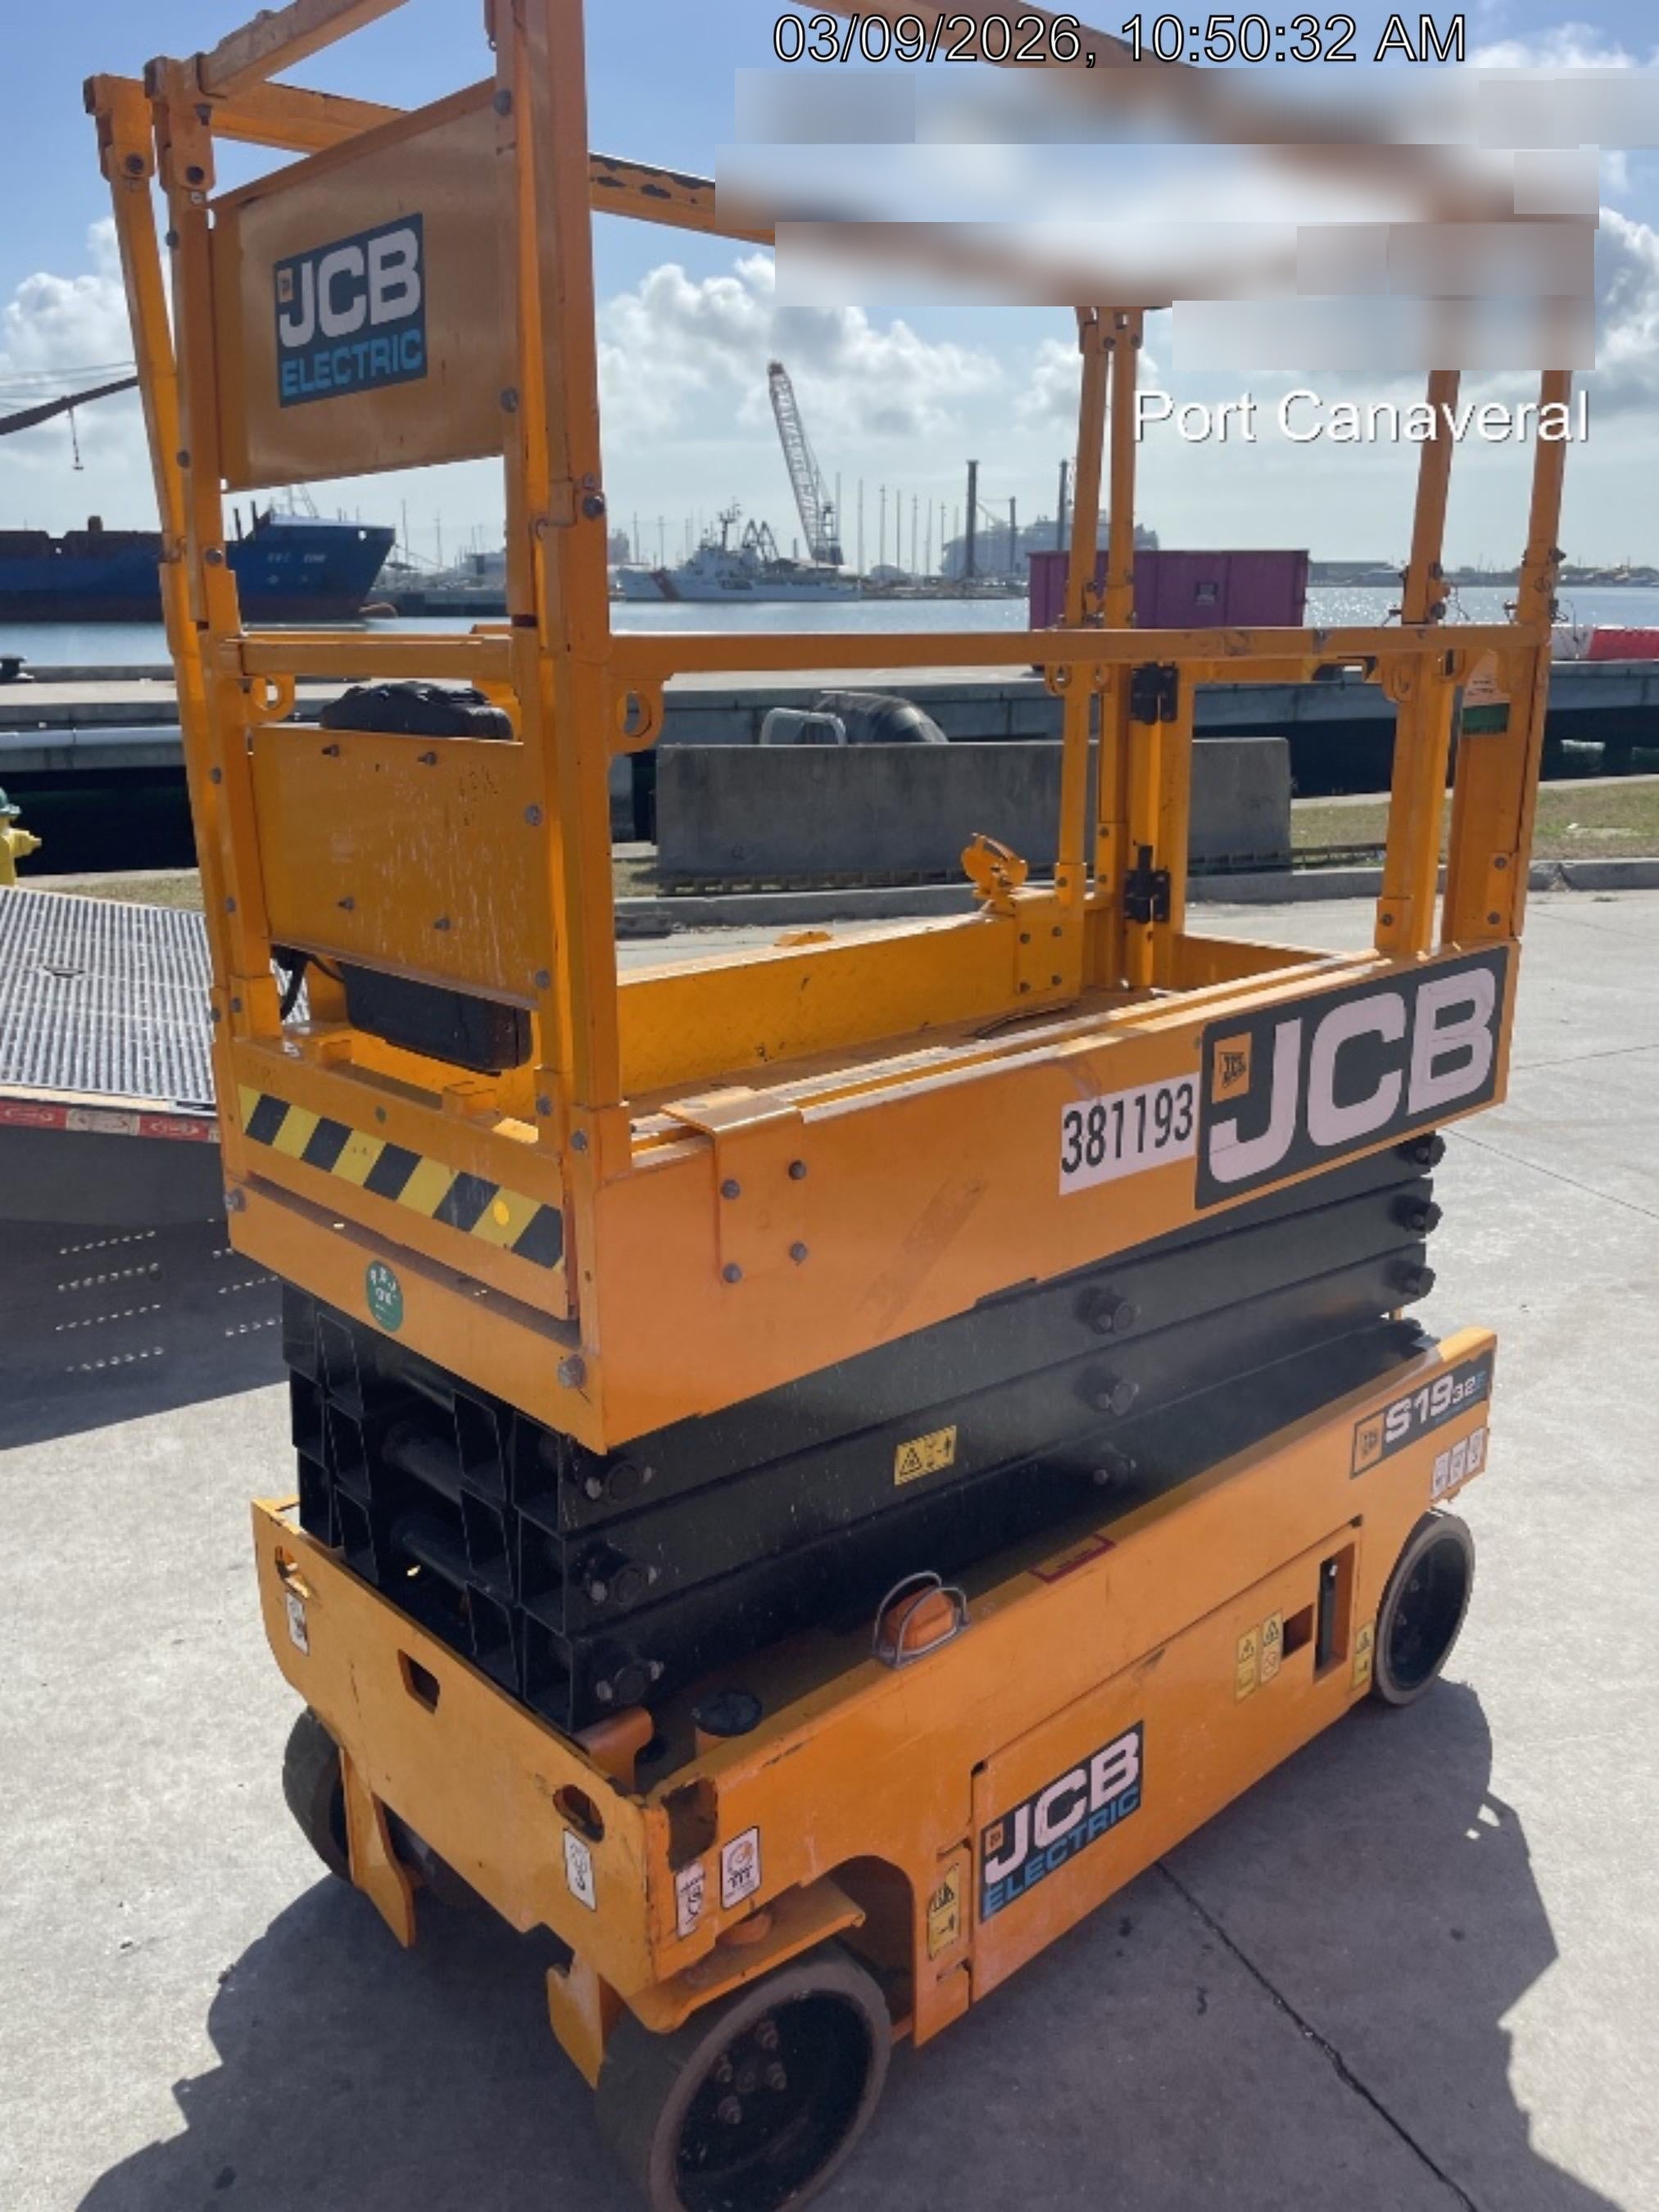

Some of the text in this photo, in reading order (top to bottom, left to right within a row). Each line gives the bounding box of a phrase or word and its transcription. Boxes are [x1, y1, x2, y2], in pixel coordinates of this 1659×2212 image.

[279, 228, 420, 347] JCB
[282, 330, 423, 397] ELECTRIC
[1061, 1082, 1194, 1175] 381193
[1208, 968, 1495, 1183] JCB
[985, 1787, 1140, 1917] ELECTRIC
[986, 1732, 1140, 1883] JCB
